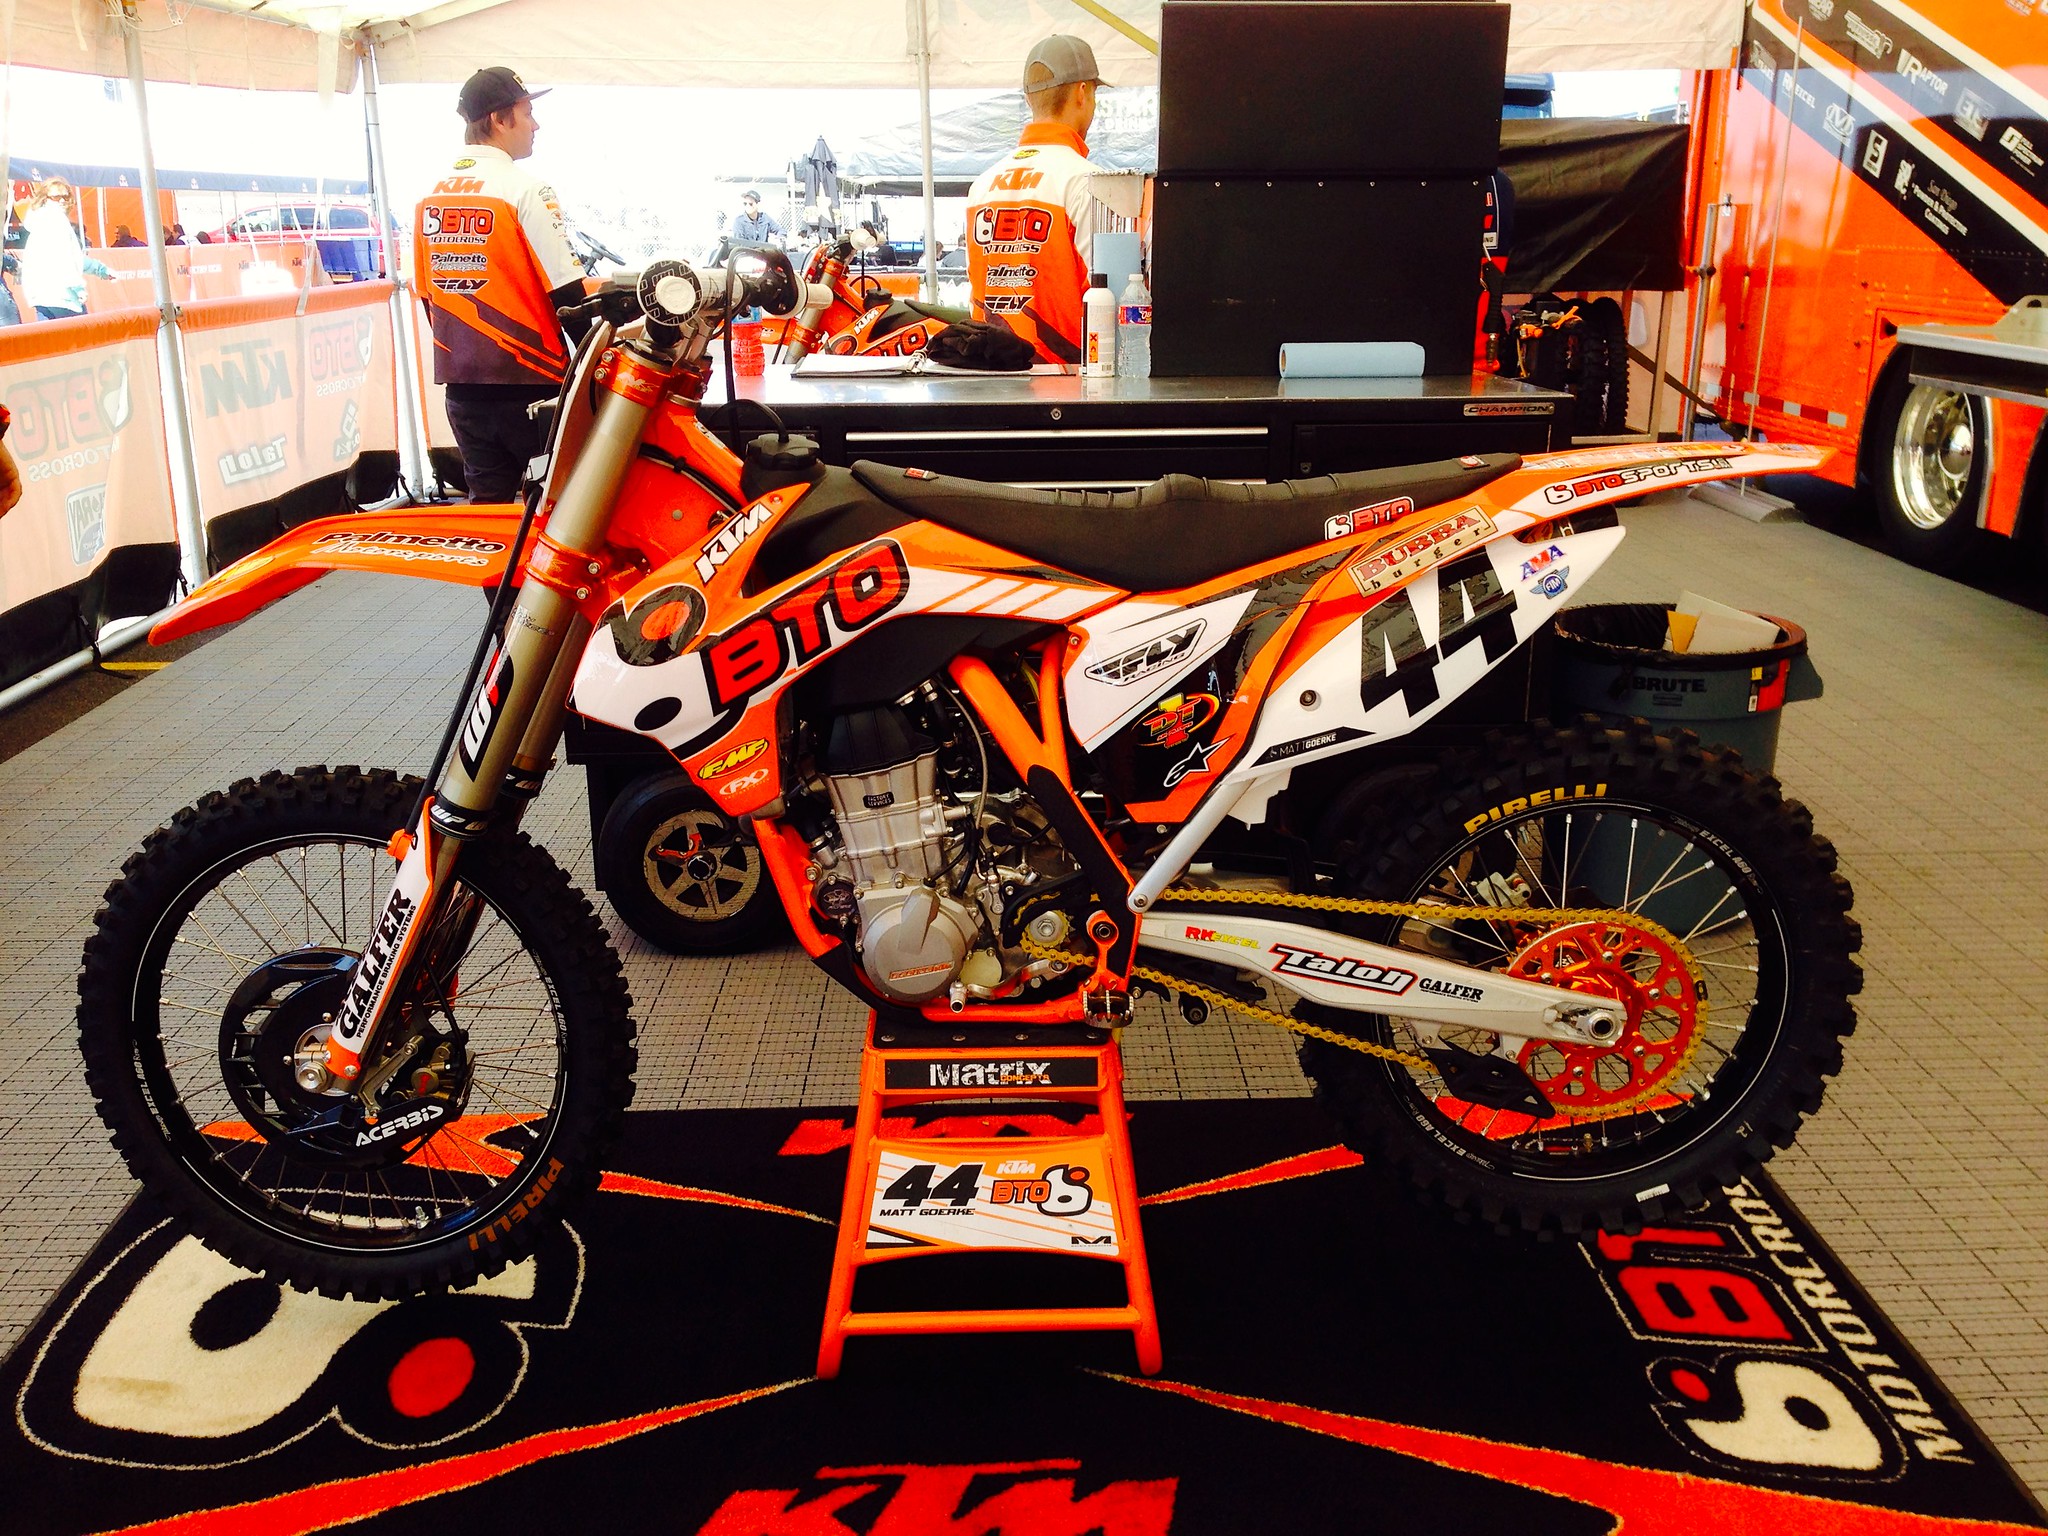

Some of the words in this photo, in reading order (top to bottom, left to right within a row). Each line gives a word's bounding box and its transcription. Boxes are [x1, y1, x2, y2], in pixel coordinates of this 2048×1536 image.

[1896, 48, 1949, 96] RAPTOR
[433, 177, 485, 194] KTM
[989, 167, 1044, 191] KTM
[441, 208, 494, 235] BTO
[854, 308, 879, 334] KTM
[1469, 405, 1549, 414] CHAMPION
[312, 531, 506, 554] Palmetto
[694, 502, 775, 584] KTM
[1357, 511, 1482, 581] BUBBA
[1371, 526, 1482, 590] burger
[1520, 545, 1568, 583] AMA
[704, 540, 908, 715] BTO
[1360, 544, 1519, 718] 44
[1088, 623, 1202, 680] FLY
[1631, 676, 1706, 692] BRUTE
[1305, 733, 1337, 749] GOERKE
[702, 738, 766, 780] FMF
[430, 804, 466, 824] WP
[1463, 783, 1608, 834] PIRELLI
[1699, 829, 1734, 857] EXCEL
[339, 888, 412, 1039] GALFER
[356, 979, 385, 1038] PERFORMANCE
[382, 942, 400, 978] BRAKING
[397, 905, 416, 942] SYSTEMS
[1276, 947, 1414, 994] Talon
[545, 976, 561, 1011] EXCEL
[1419, 977, 1484, 1001] GALFER
[929, 1060, 1053, 1087] Matrix
[140, 1081, 159, 1115] EXCEL
[356, 1105, 445, 1148] ACERBIS
[1433, 1129, 1467, 1157] EXCEL
[996, 1160, 1037, 1174] KTM
[883, 1164, 984, 1208] 44
[990, 1180, 1052, 1204] BTO
[467, 1157, 565, 1251] PIRELLI
[879, 1208, 917, 1217] MATT
[919, 1207, 976, 1216] GOERKE
